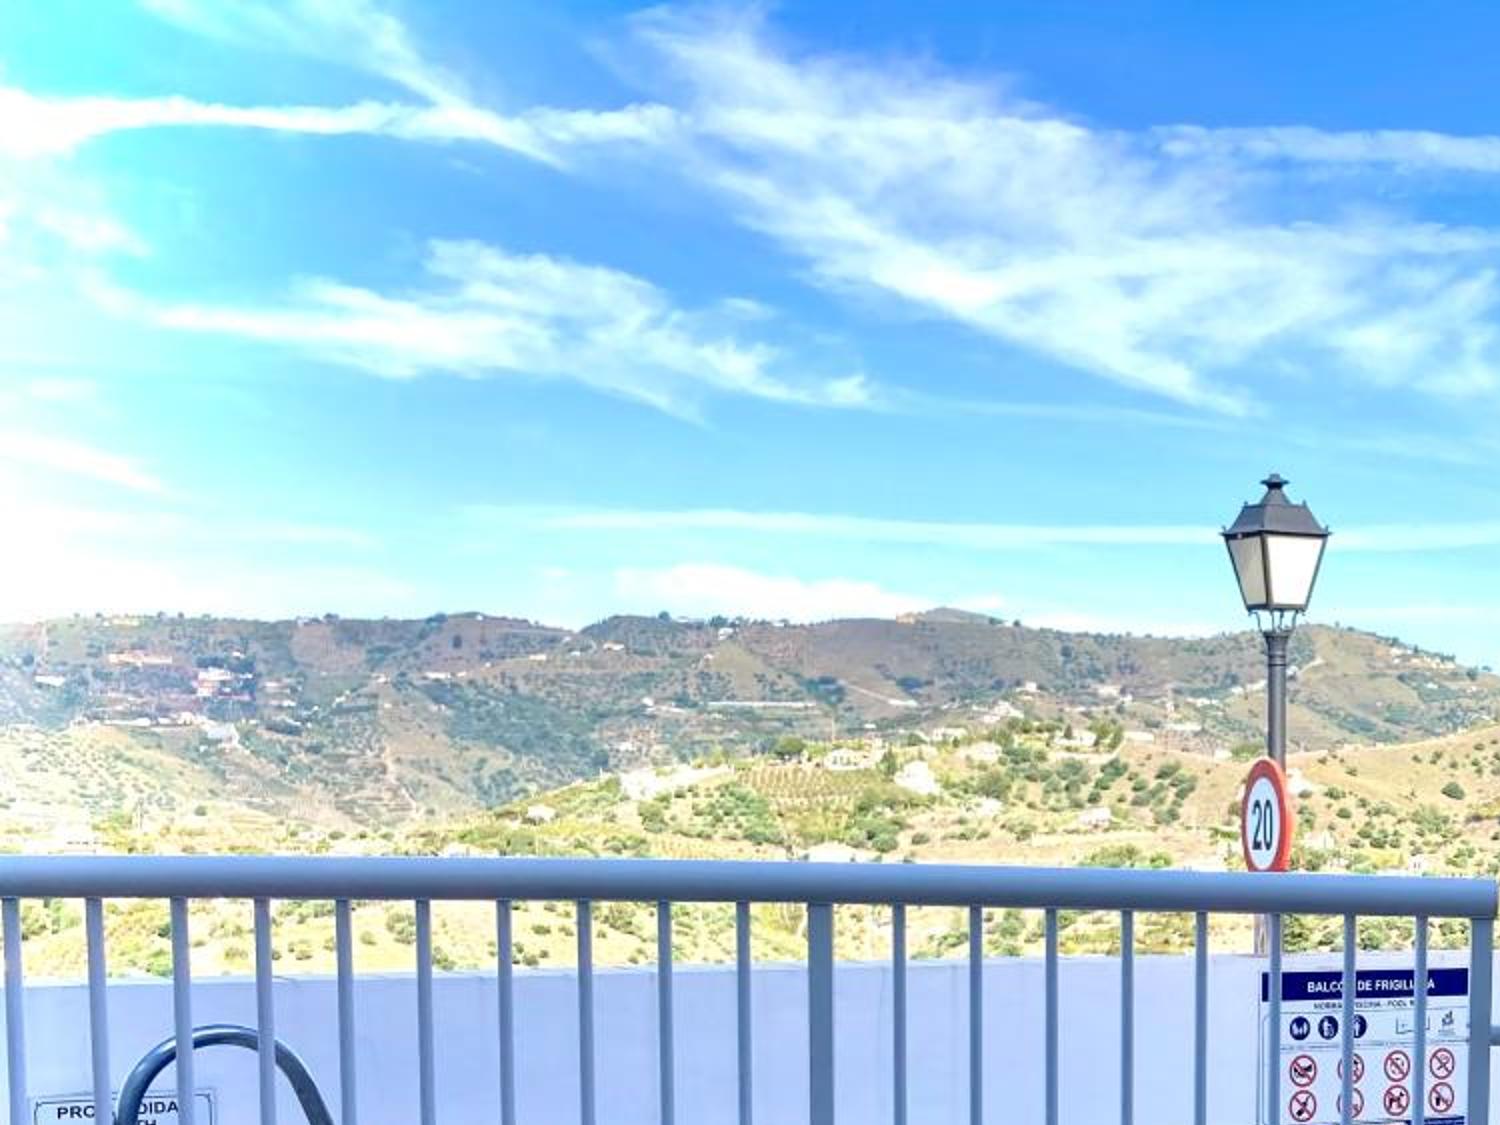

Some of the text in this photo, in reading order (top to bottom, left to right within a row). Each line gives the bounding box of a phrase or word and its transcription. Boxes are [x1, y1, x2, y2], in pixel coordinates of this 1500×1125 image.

[1252, 799, 1273, 850] 20
[1357, 979, 1372, 991] DE
[1375, 978, 1435, 991] FRIGILIA
